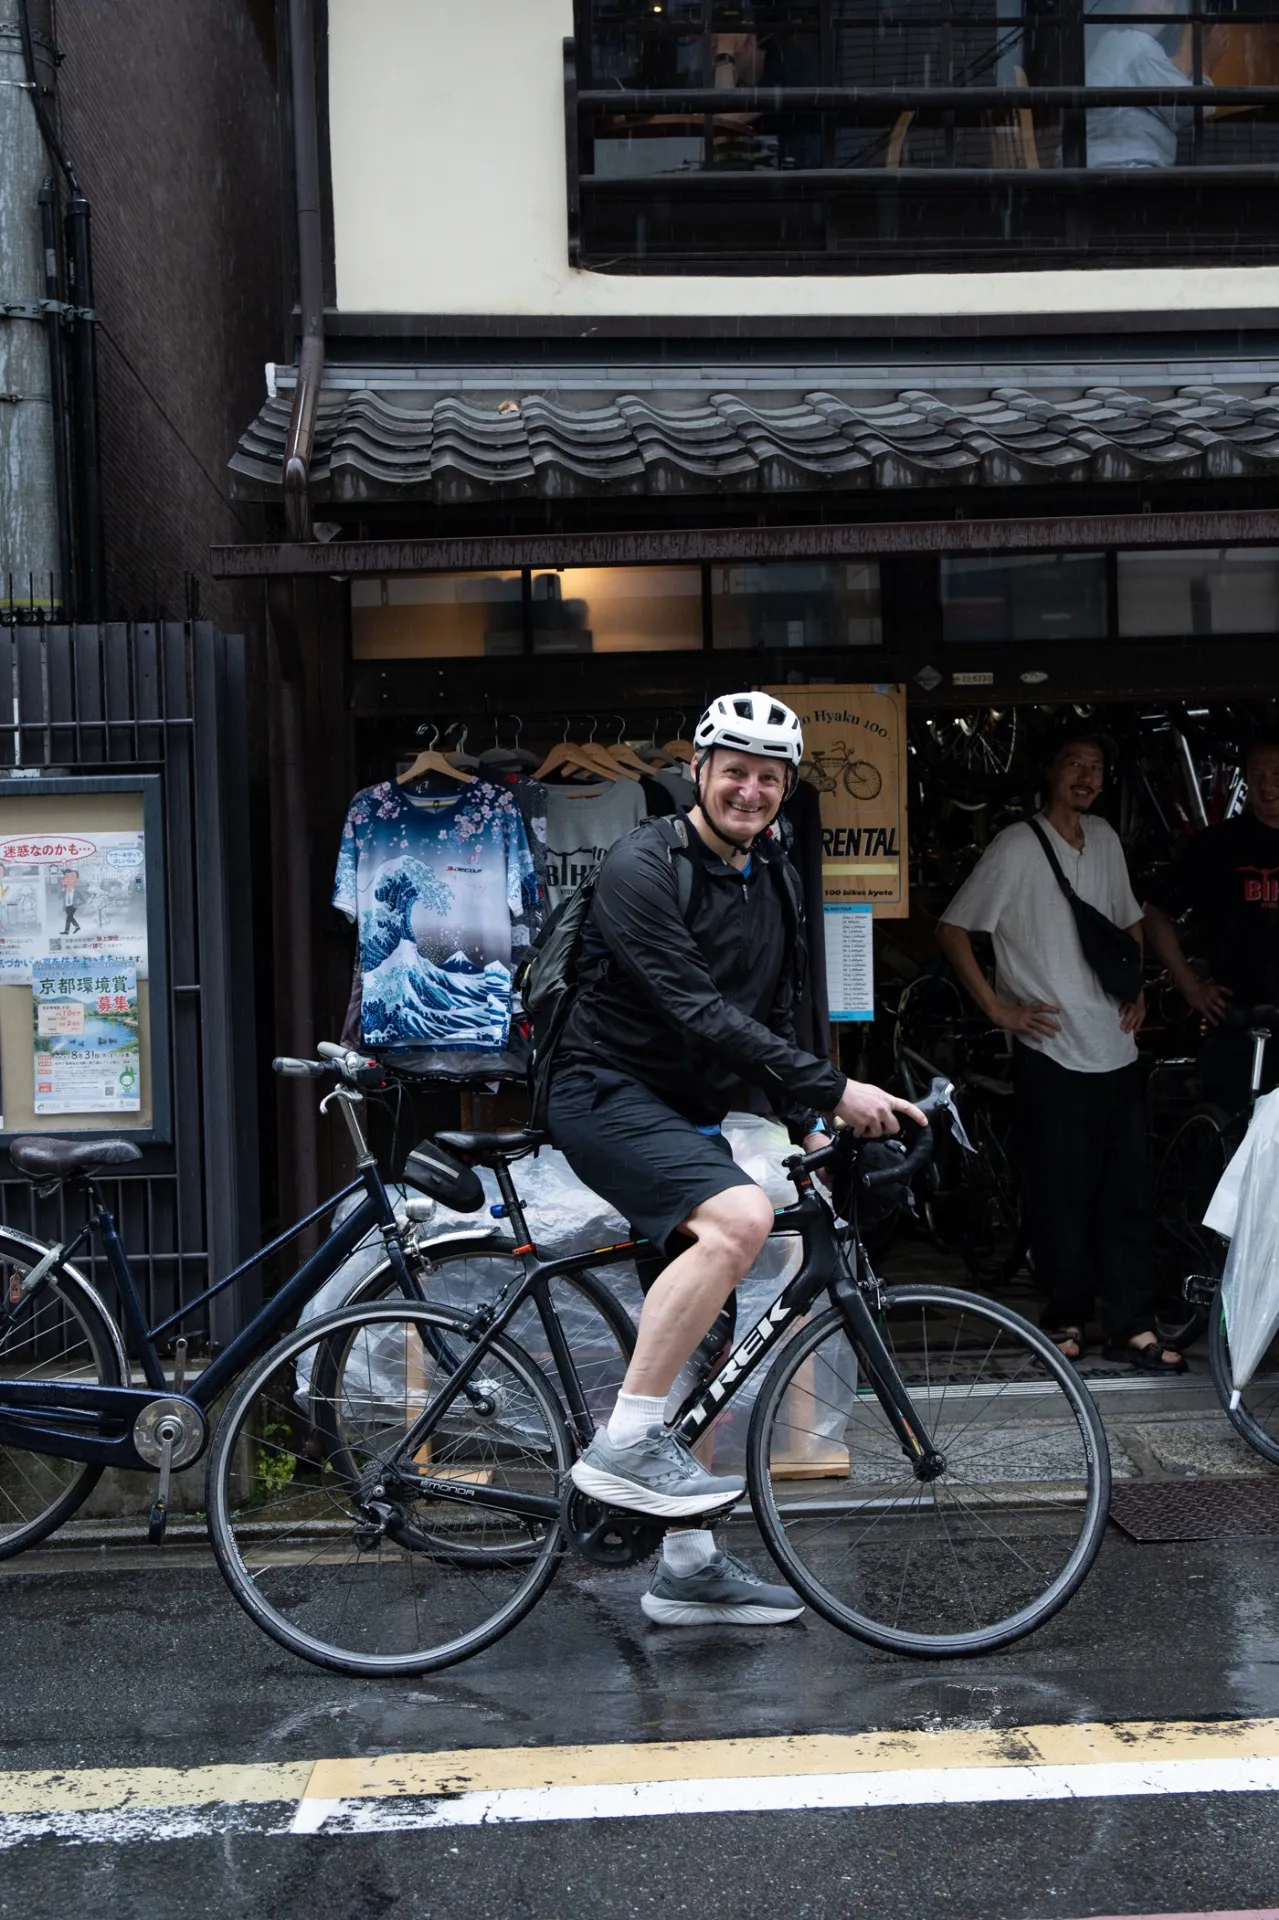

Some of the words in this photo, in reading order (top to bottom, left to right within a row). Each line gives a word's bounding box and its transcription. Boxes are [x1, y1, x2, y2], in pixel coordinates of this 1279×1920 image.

[813, 709, 861, 726] Hyaku
[822, 827, 900, 857] RENTAL
[868, 889, 894, 898] kyoto
[39, 975, 128, 995] 京都環境賞
[97, 995, 129, 1013] 募集
[681, 1294, 792, 1426] TREK
[1077, 1412, 1094, 1464] BONTRAGER
[226, 1523, 248, 1574] BONTRAGER
